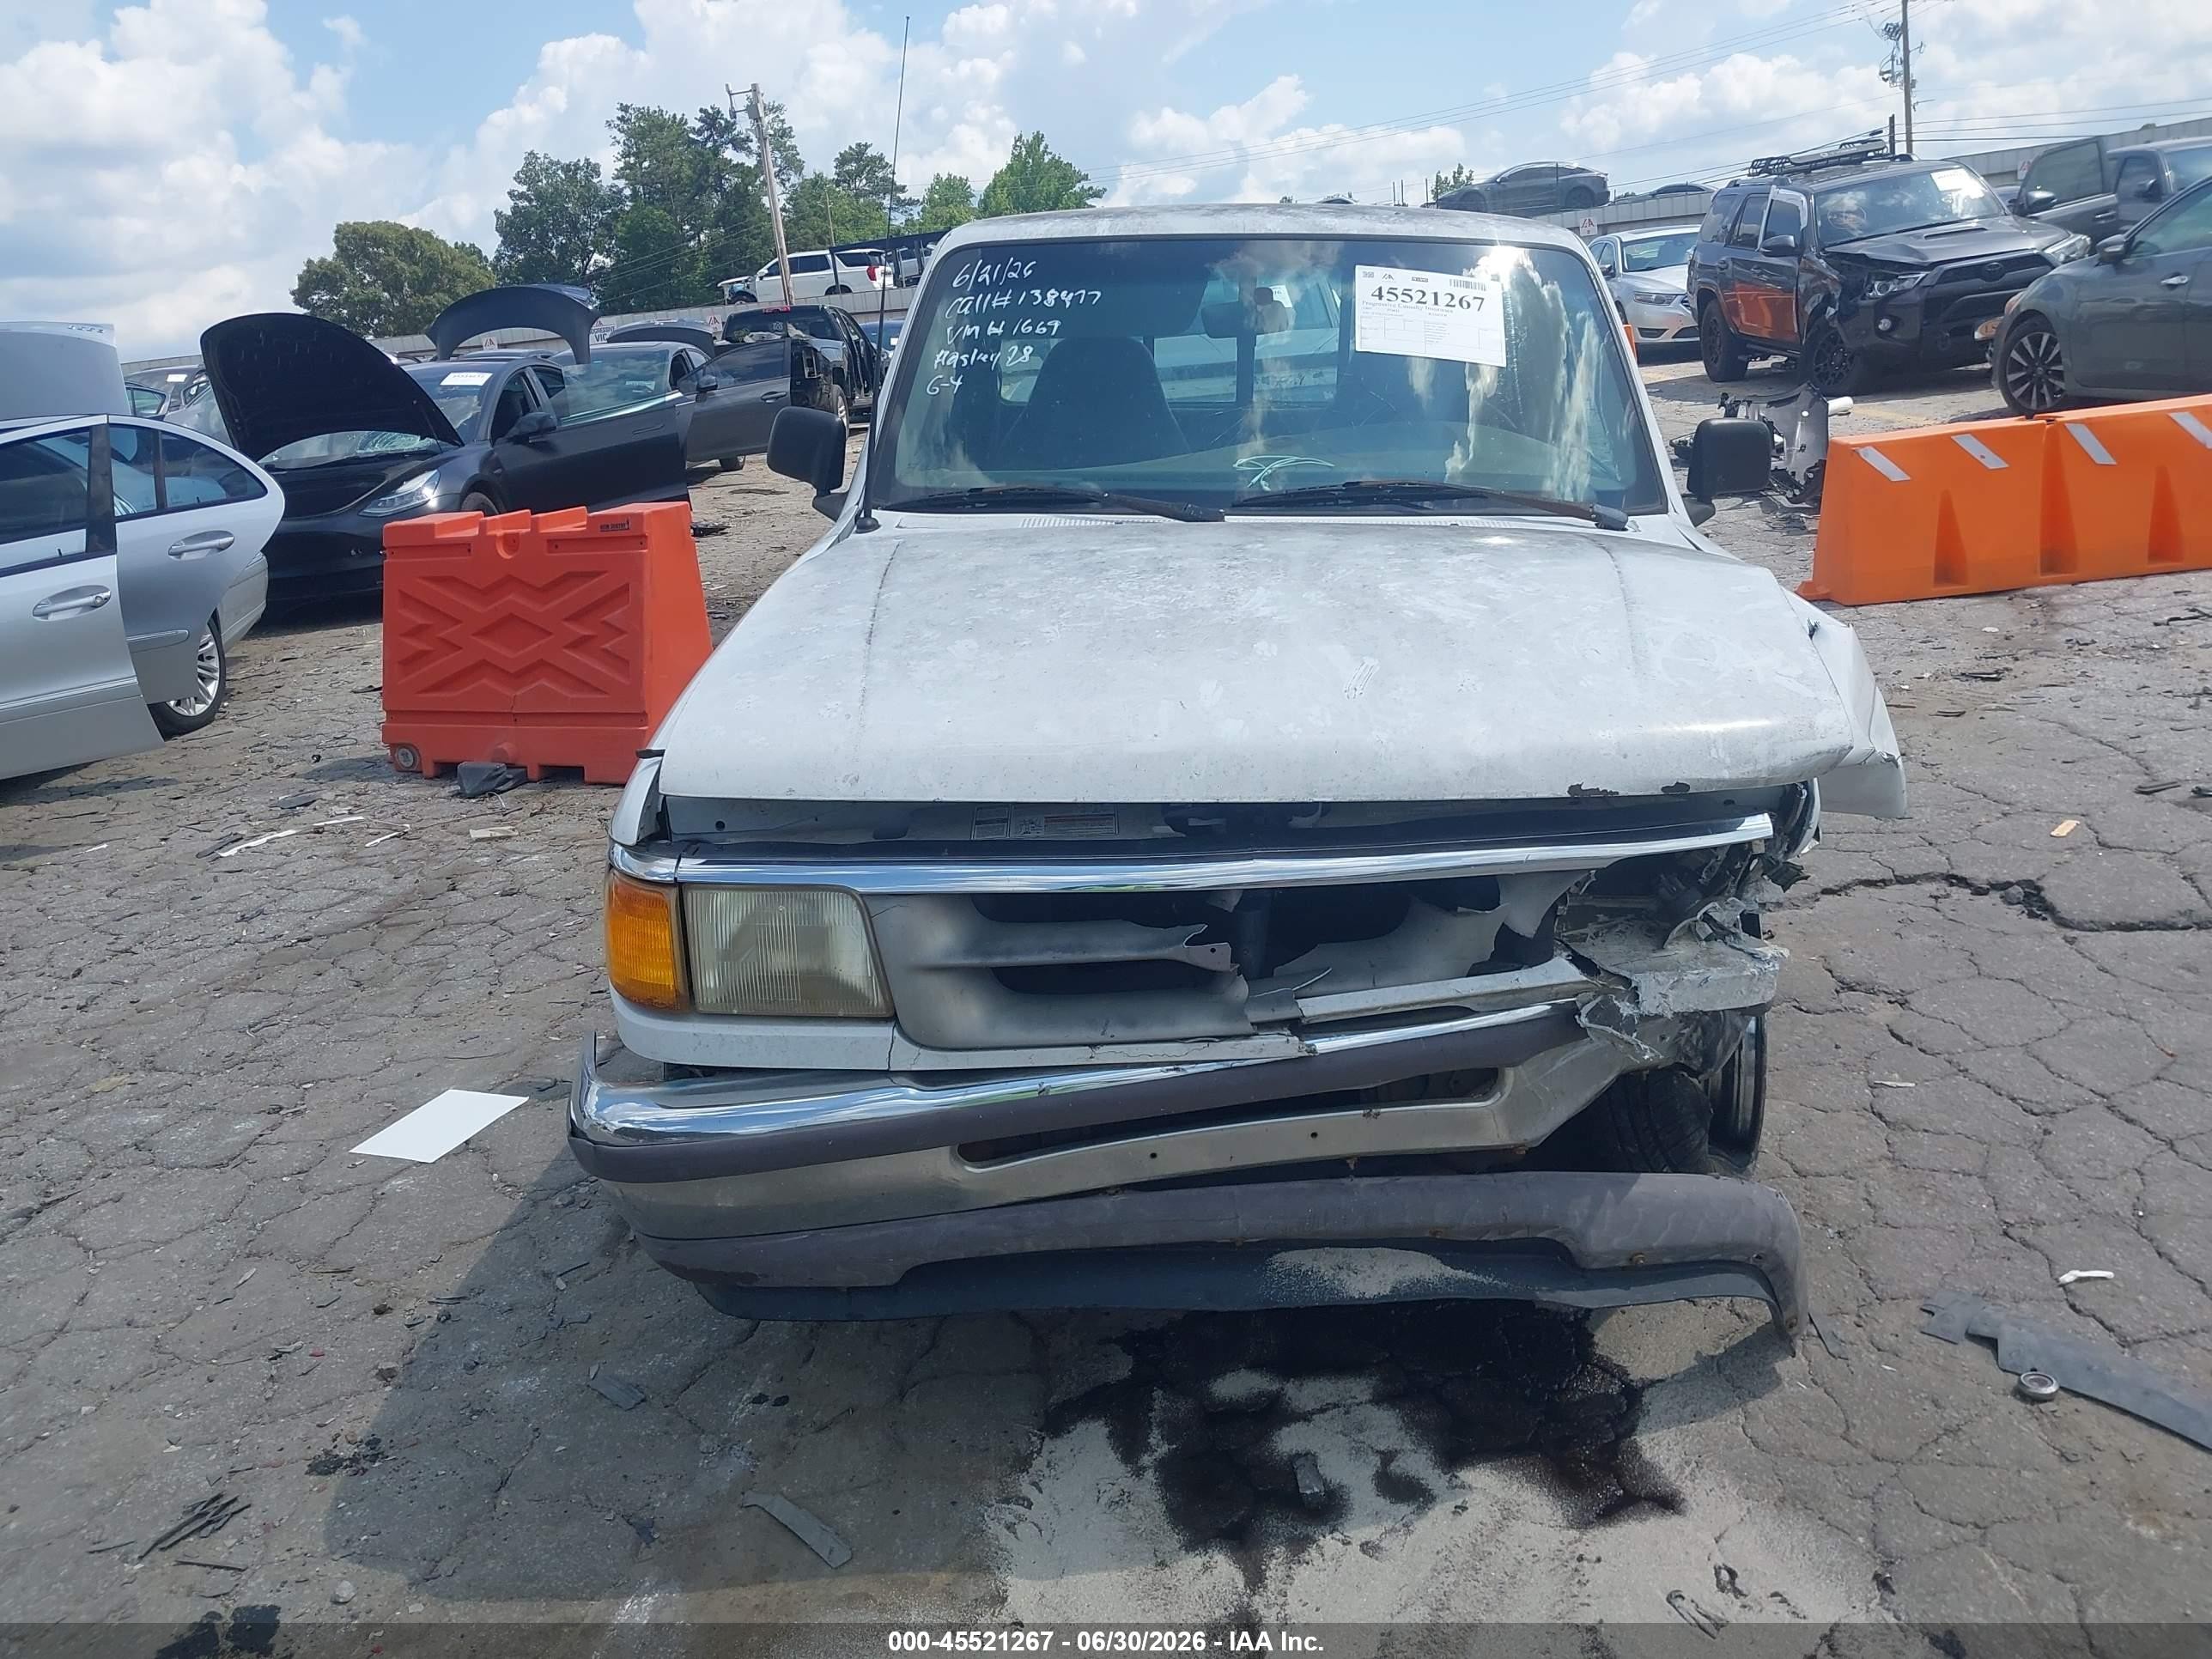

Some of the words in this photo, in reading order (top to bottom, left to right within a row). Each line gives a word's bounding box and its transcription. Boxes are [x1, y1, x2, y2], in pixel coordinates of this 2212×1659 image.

[951, 257, 1036, 292] 6/21/26
[1370, 285, 1486, 313] 45521267
[1012, 318, 1062, 337] 1669
